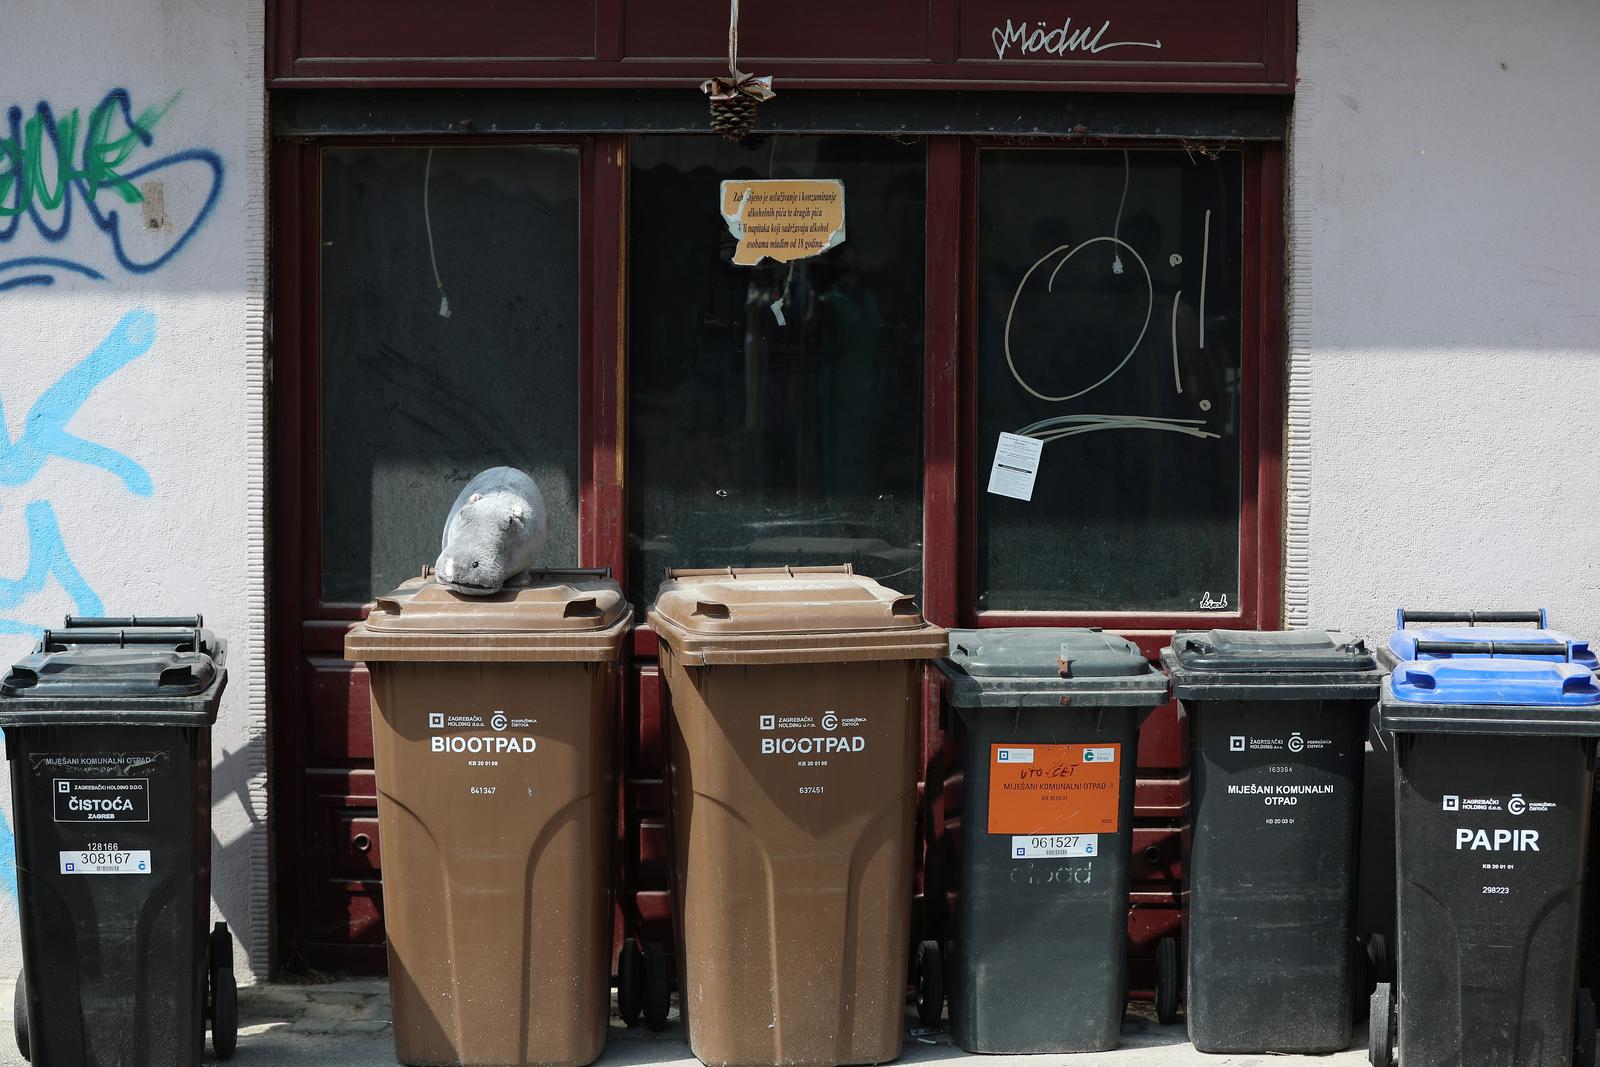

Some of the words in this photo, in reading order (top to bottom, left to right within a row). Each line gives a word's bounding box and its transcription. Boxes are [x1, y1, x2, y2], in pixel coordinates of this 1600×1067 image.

[431, 736, 537, 753] BIOOTPAD
[761, 736, 866, 754] BIOOTPAD
[45, 756, 79, 765] MIJEŠANI
[80, 756, 125, 765] KOMUNALNI
[470, 786, 496, 794] 641347
[799, 786, 824, 794] 637451
[1003, 782, 1038, 790] MIJEŠANI
[1040, 782, 1081, 790] KOMUNALNI
[1083, 782, 1106, 790] OTPAD
[1228, 784, 1274, 794] MIJEŠANI
[1276, 785, 1334, 794] KOMUNALNI
[68, 796, 134, 811] ČISTOĆA
[1264, 796, 1298, 806] OTPAD
[1031, 837, 1079, 849] 061527
[1456, 828, 1540, 852] PAPIR
[87, 842, 119, 851] 128166
[80, 852, 131, 865] 308167
[1482, 886, 1510, 894] 298223
